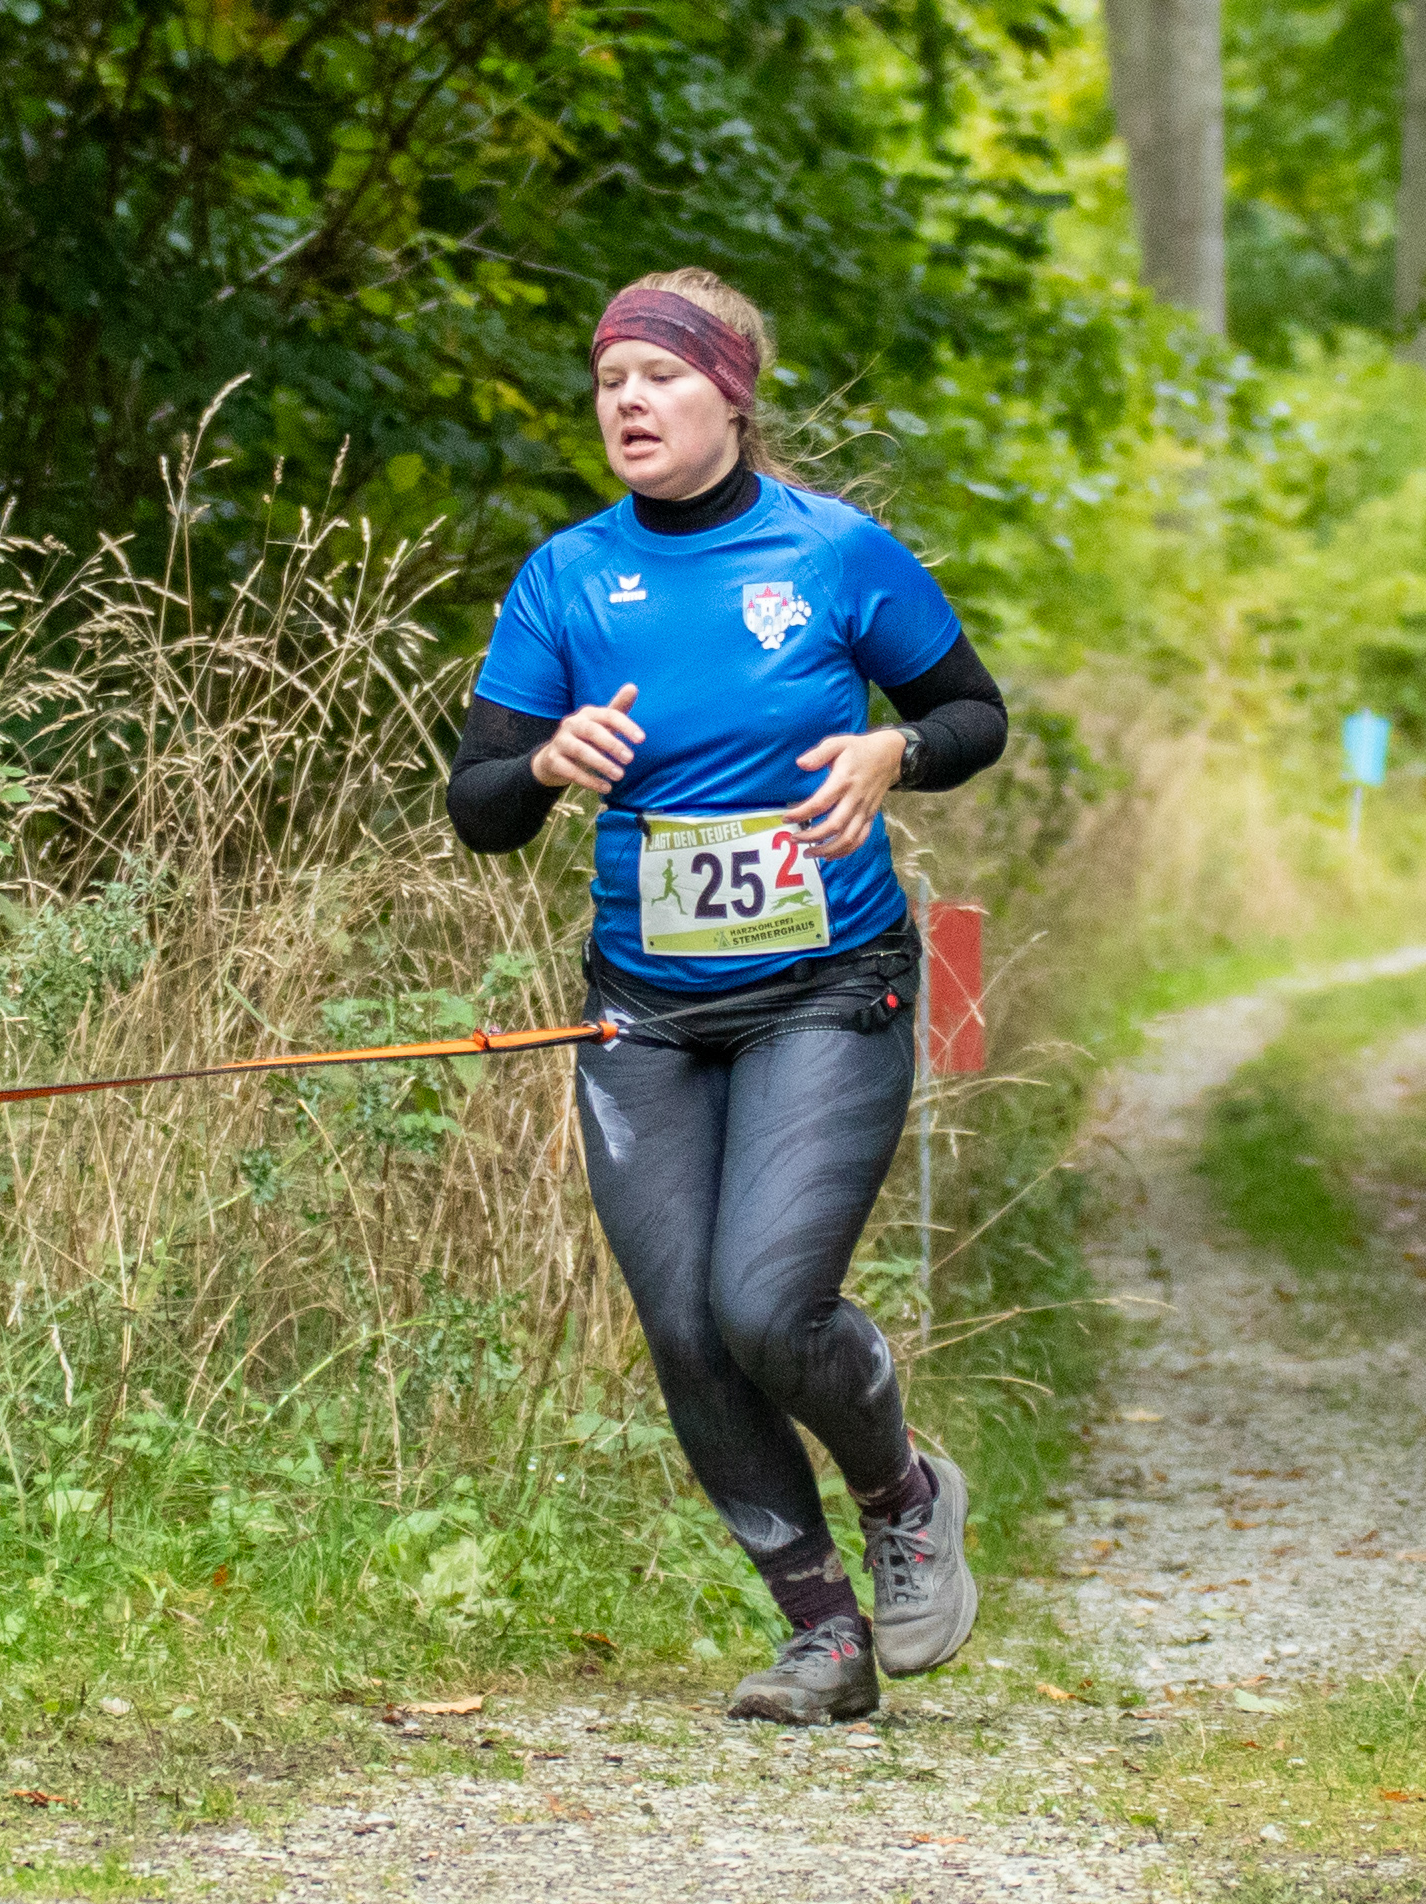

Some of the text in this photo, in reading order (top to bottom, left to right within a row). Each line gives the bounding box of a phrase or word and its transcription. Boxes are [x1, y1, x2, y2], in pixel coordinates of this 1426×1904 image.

[673, 828, 697, 848] DEN
[699, 820, 746, 845] TEUFEL
[772, 831, 804, 889] 2
[691, 850, 766, 919] 25
[733, 921, 815, 946] STEMBERGHAUS
